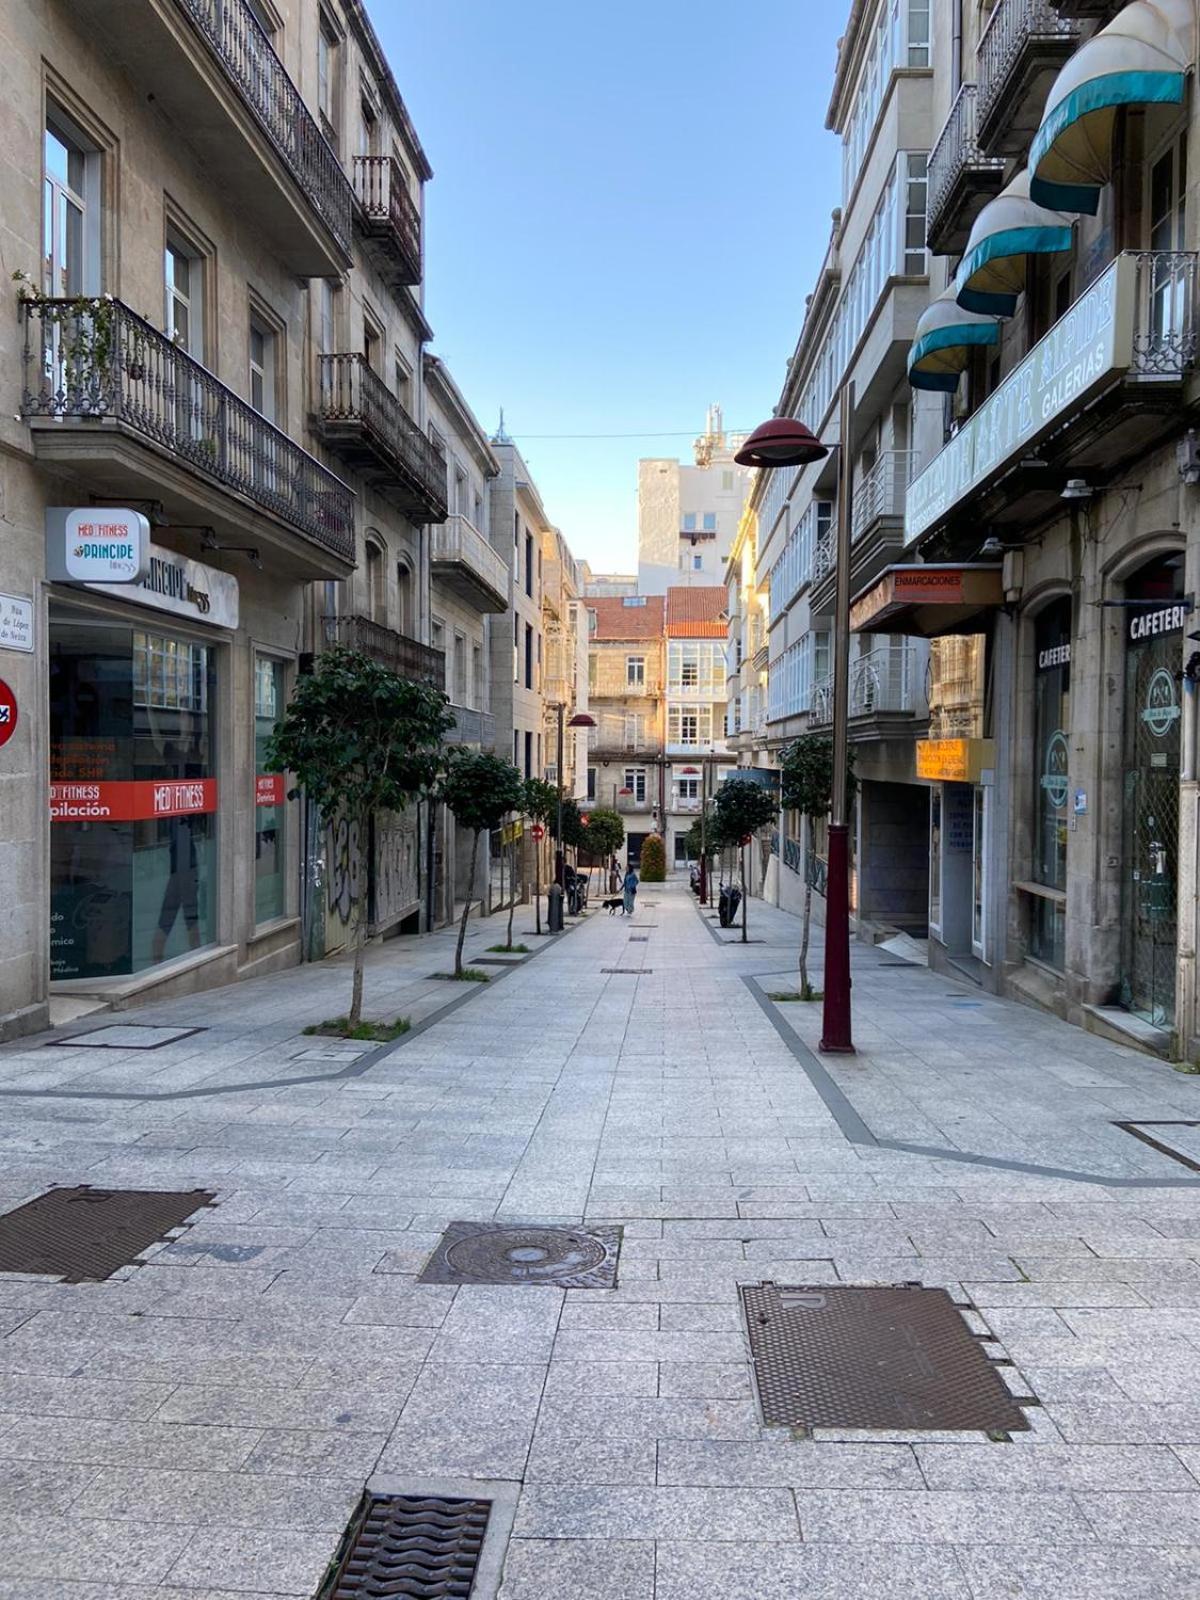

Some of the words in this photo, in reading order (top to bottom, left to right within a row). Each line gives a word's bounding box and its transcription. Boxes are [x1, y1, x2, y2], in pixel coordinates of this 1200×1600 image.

[1042, 342, 1105, 419] GALERIAS
[84, 543, 133, 560] PRINCIPE
[895, 576, 961, 586] ENMARCACIONES
[1130, 605, 1184, 640] CAFETERI
[1039, 643, 1071, 668] CAFETER
[63, 785, 100, 799] FITNESS
[175, 784, 204, 810] FITNESS
[50, 801, 111, 821] pilación
